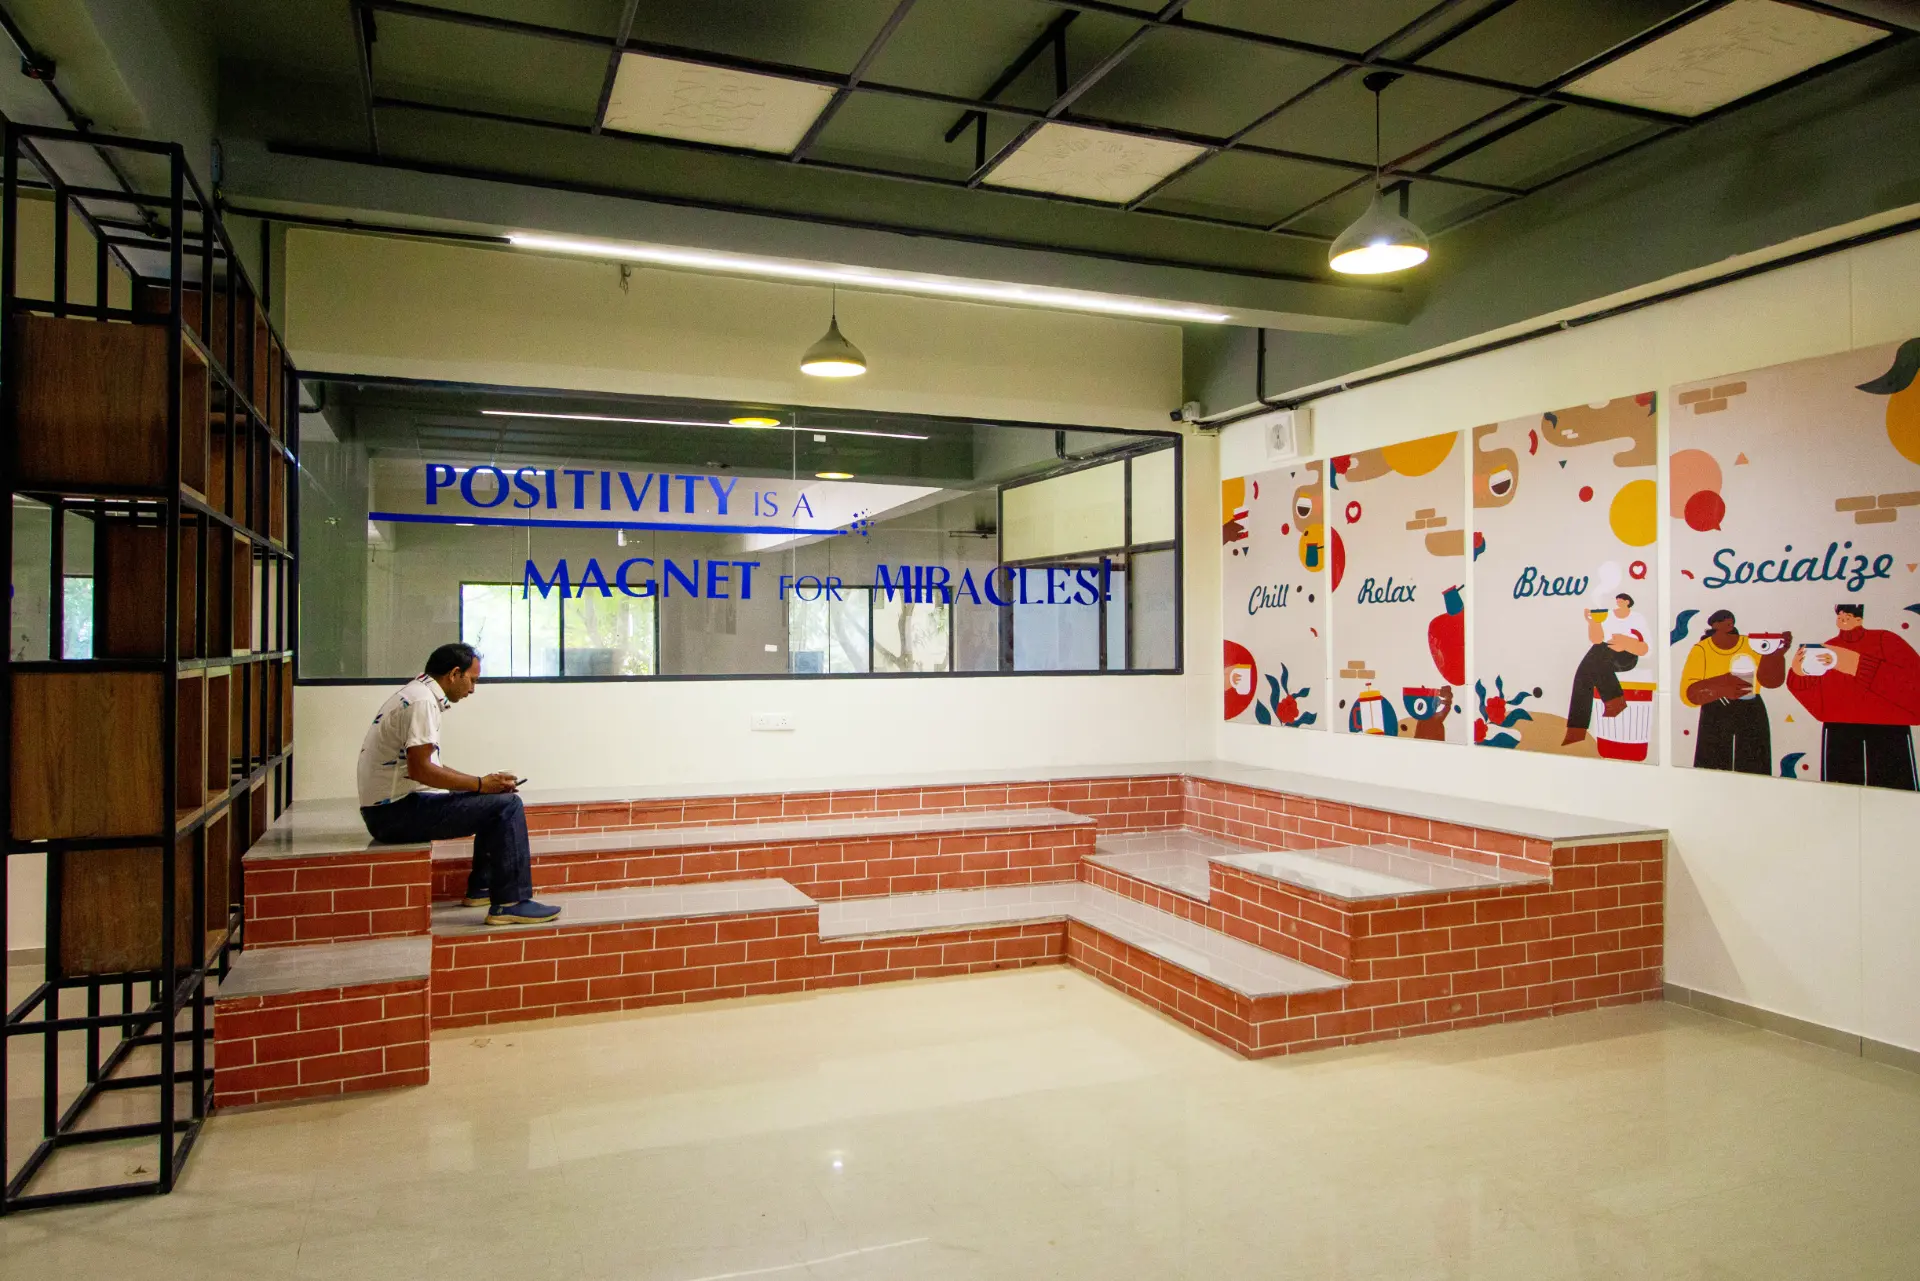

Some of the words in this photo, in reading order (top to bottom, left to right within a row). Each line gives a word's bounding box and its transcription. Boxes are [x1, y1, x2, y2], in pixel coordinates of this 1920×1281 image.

[425, 463, 739, 515] POSITIVITY
[753, 491, 779, 517] IS
[791, 493, 814, 518] A
[522, 557, 761, 600] MAGNET
[779, 575, 843, 601] FOR
[873, 558, 1112, 607] MIRACLES!
[1513, 566, 1589, 599] Brew
[1702, 540, 1894, 592] Socialize
[1248, 583, 1289, 616] Chill
[1357, 576, 1417, 604] Relax
